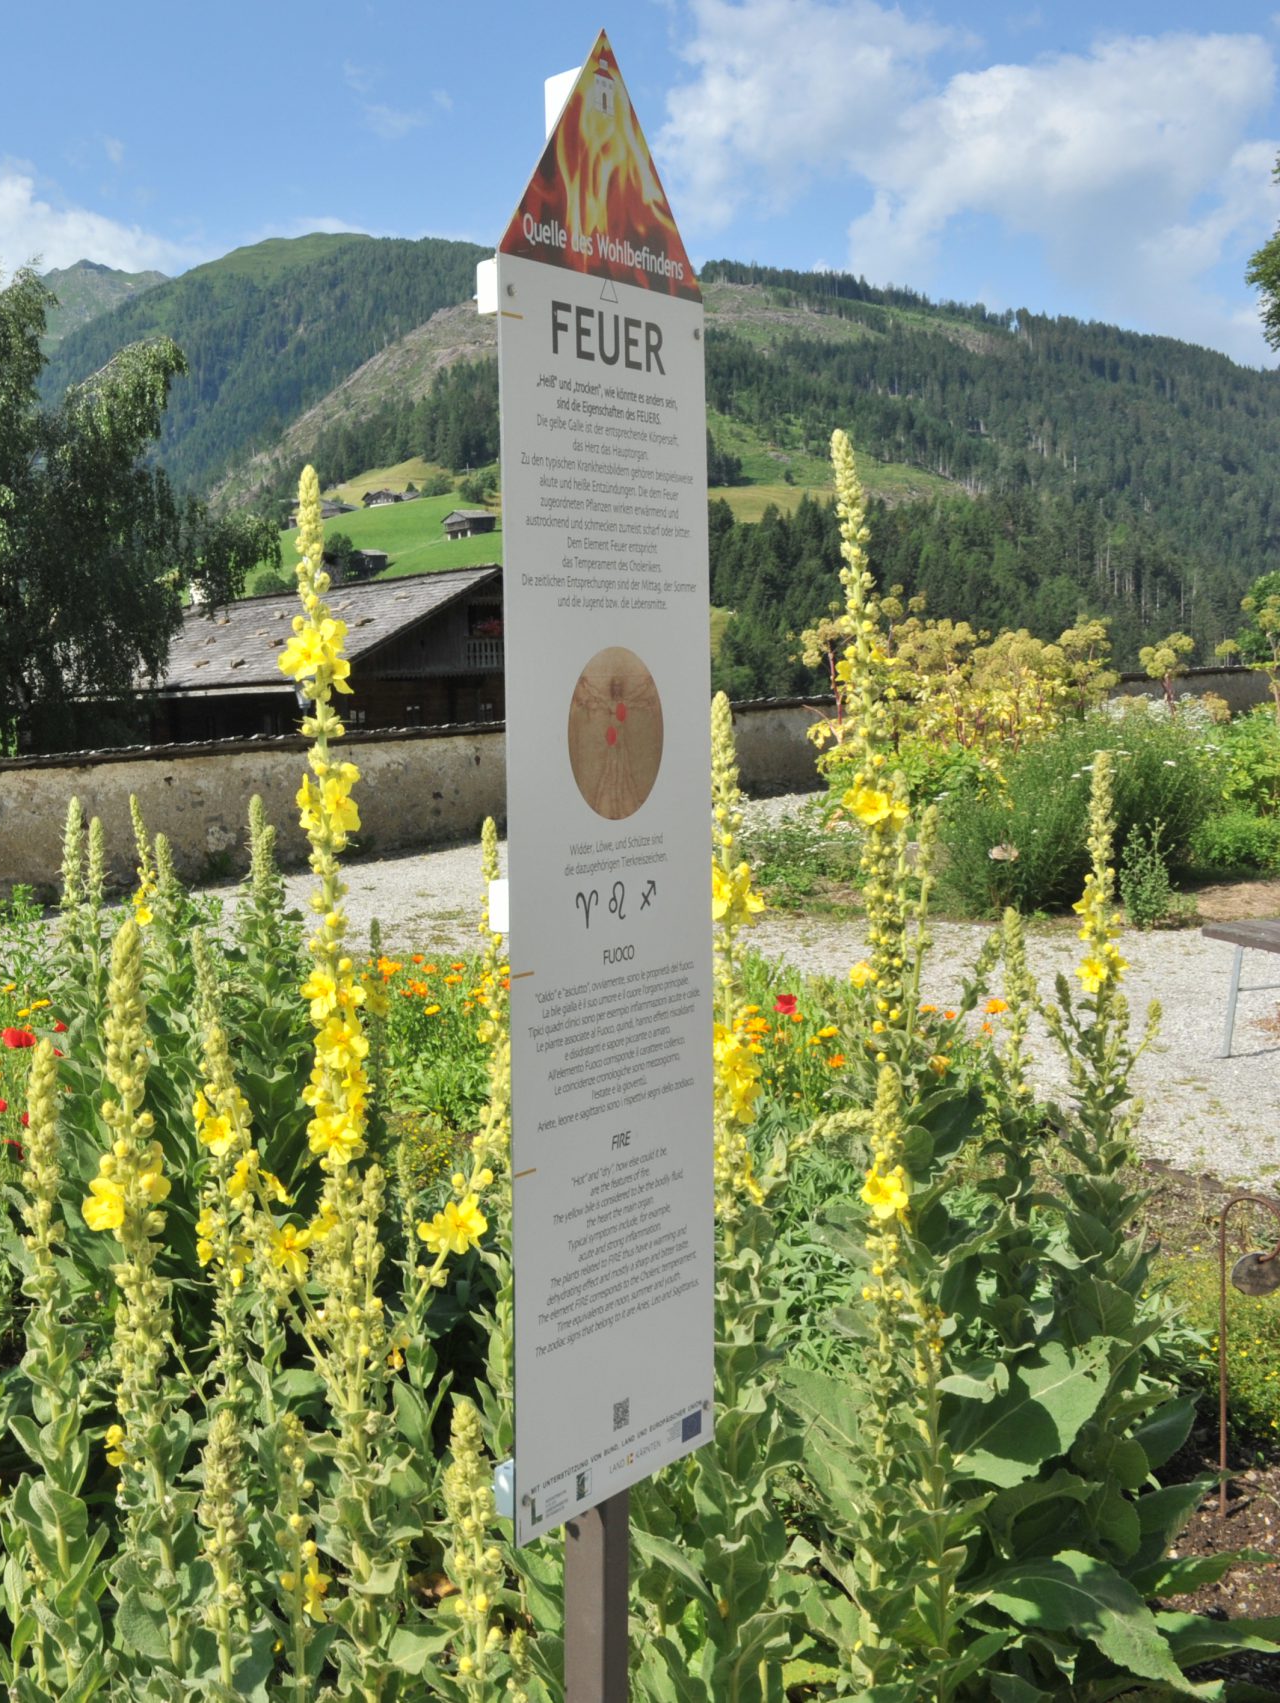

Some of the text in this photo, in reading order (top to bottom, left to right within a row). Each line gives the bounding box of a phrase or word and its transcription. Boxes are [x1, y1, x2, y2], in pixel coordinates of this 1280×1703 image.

[523, 213, 683, 280] Quelle des Wohlbefindens
[552, 300, 666, 376] FEUER
[558, 378, 571, 391] und
[604, 386, 615, 398] wie
[616, 387, 637, 402] könnte
[637, 393, 644, 403] es
[645, 394, 664, 407] anders
[556, 396, 570, 410] sind
[570, 398, 581, 412] die
[625, 407, 635, 420] des
[603, 945, 635, 965] FUOCO
[611, 1131, 631, 1150] FIRE
